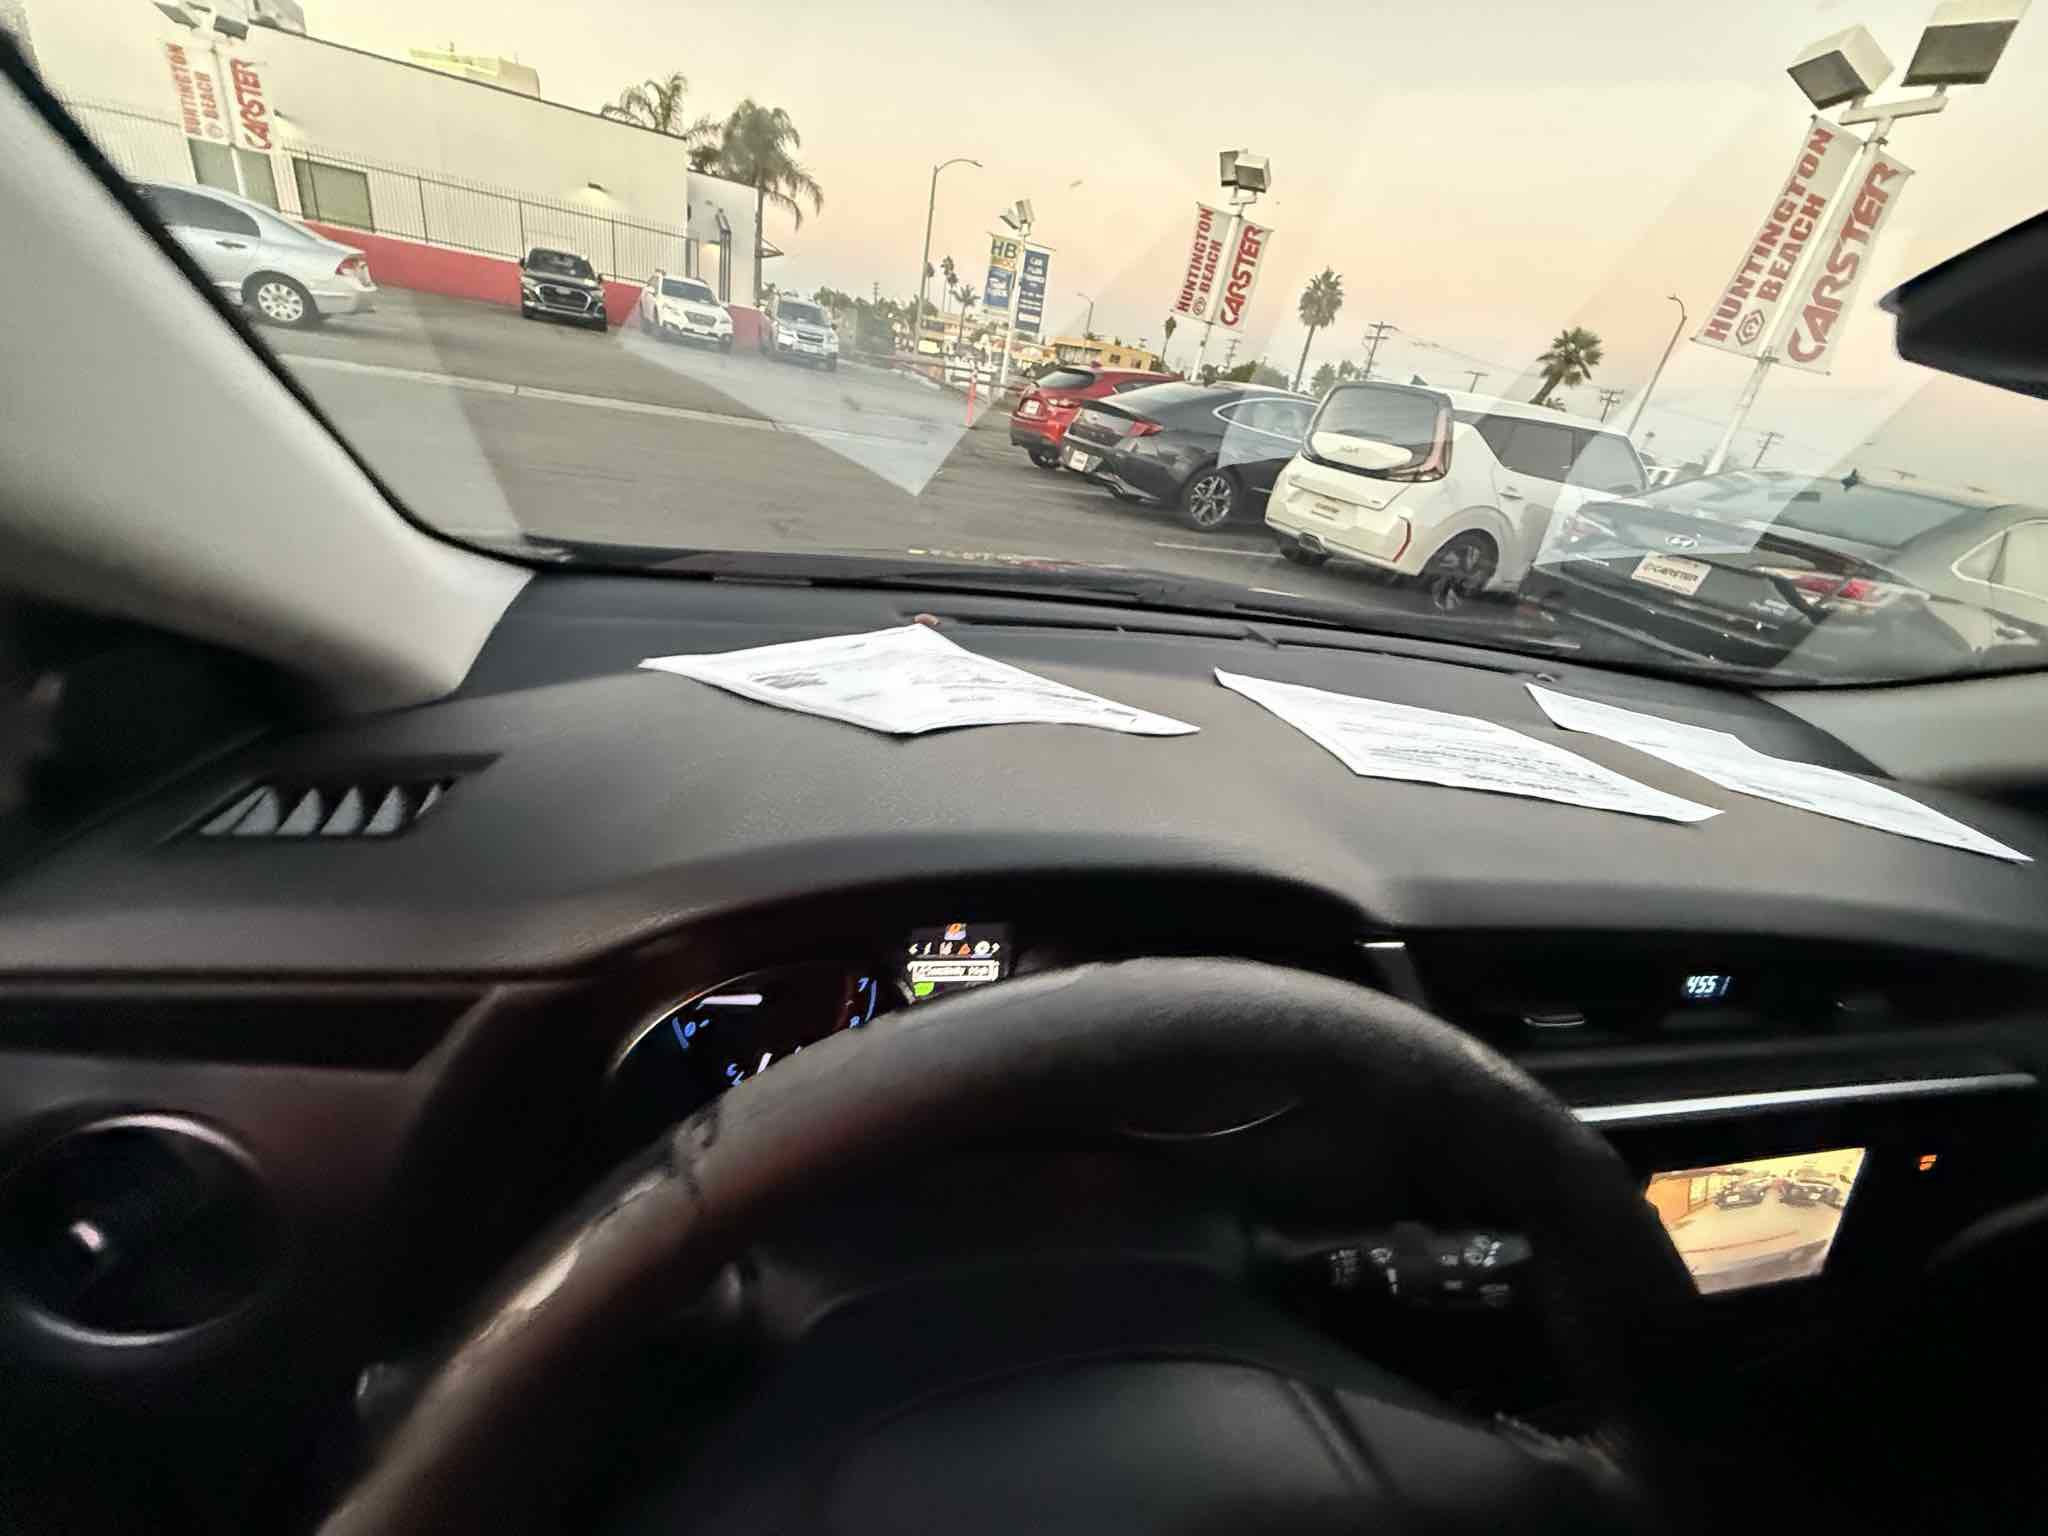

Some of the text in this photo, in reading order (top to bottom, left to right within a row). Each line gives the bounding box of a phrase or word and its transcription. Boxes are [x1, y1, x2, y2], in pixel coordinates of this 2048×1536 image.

[991, 239, 1017, 259] HB
[1176, 206, 1215, 313] HUNTINGTON
[1198, 239, 1223, 293] BEACH
[1220, 224, 1265, 326] CARSTER
[1703, 126, 1834, 342] HUNTINGTON
[1756, 193, 1826, 302] BEACH
[1787, 161, 1899, 363] CARSTER
